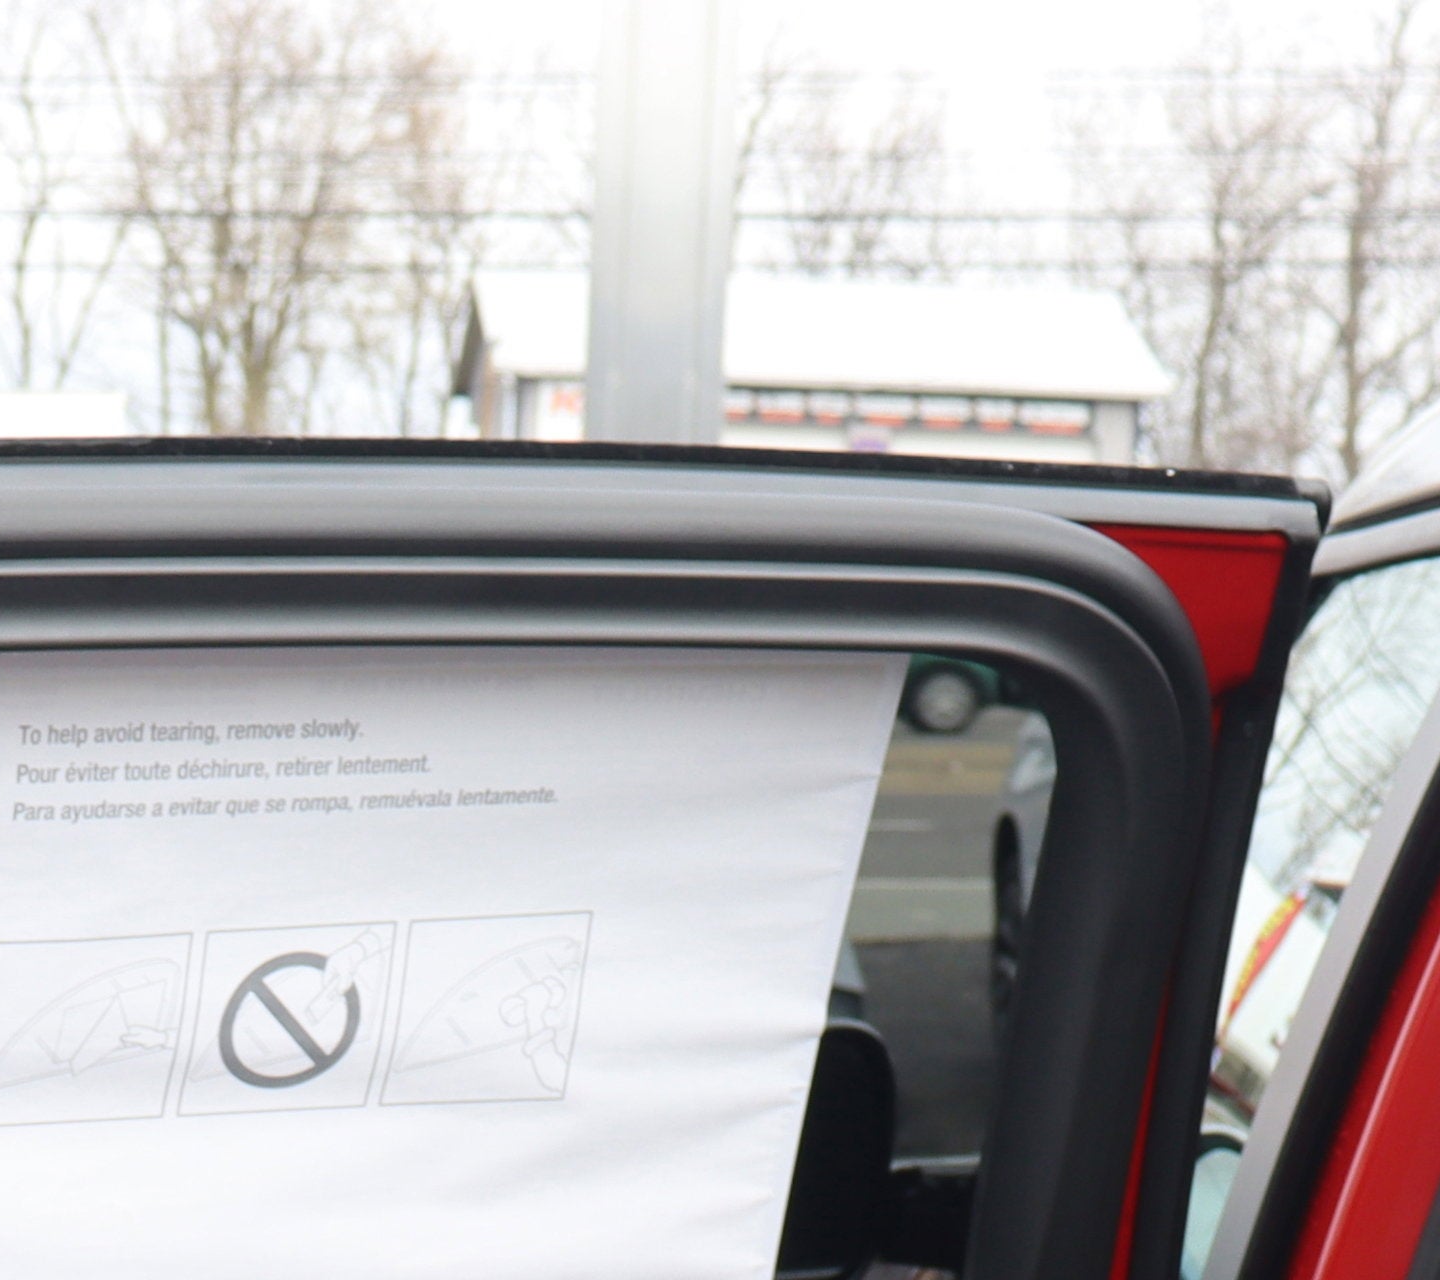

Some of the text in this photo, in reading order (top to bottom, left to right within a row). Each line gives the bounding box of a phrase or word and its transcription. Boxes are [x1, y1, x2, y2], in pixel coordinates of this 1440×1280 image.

[18, 717, 364, 748] To help avoid tearing, remove slowly.
[16, 754, 431, 784] Pour éviter toute déchirure, retirer lentement.
[12, 786, 558, 824] Para ayudarse a evitar que se rompa, remuévala lentamente.
